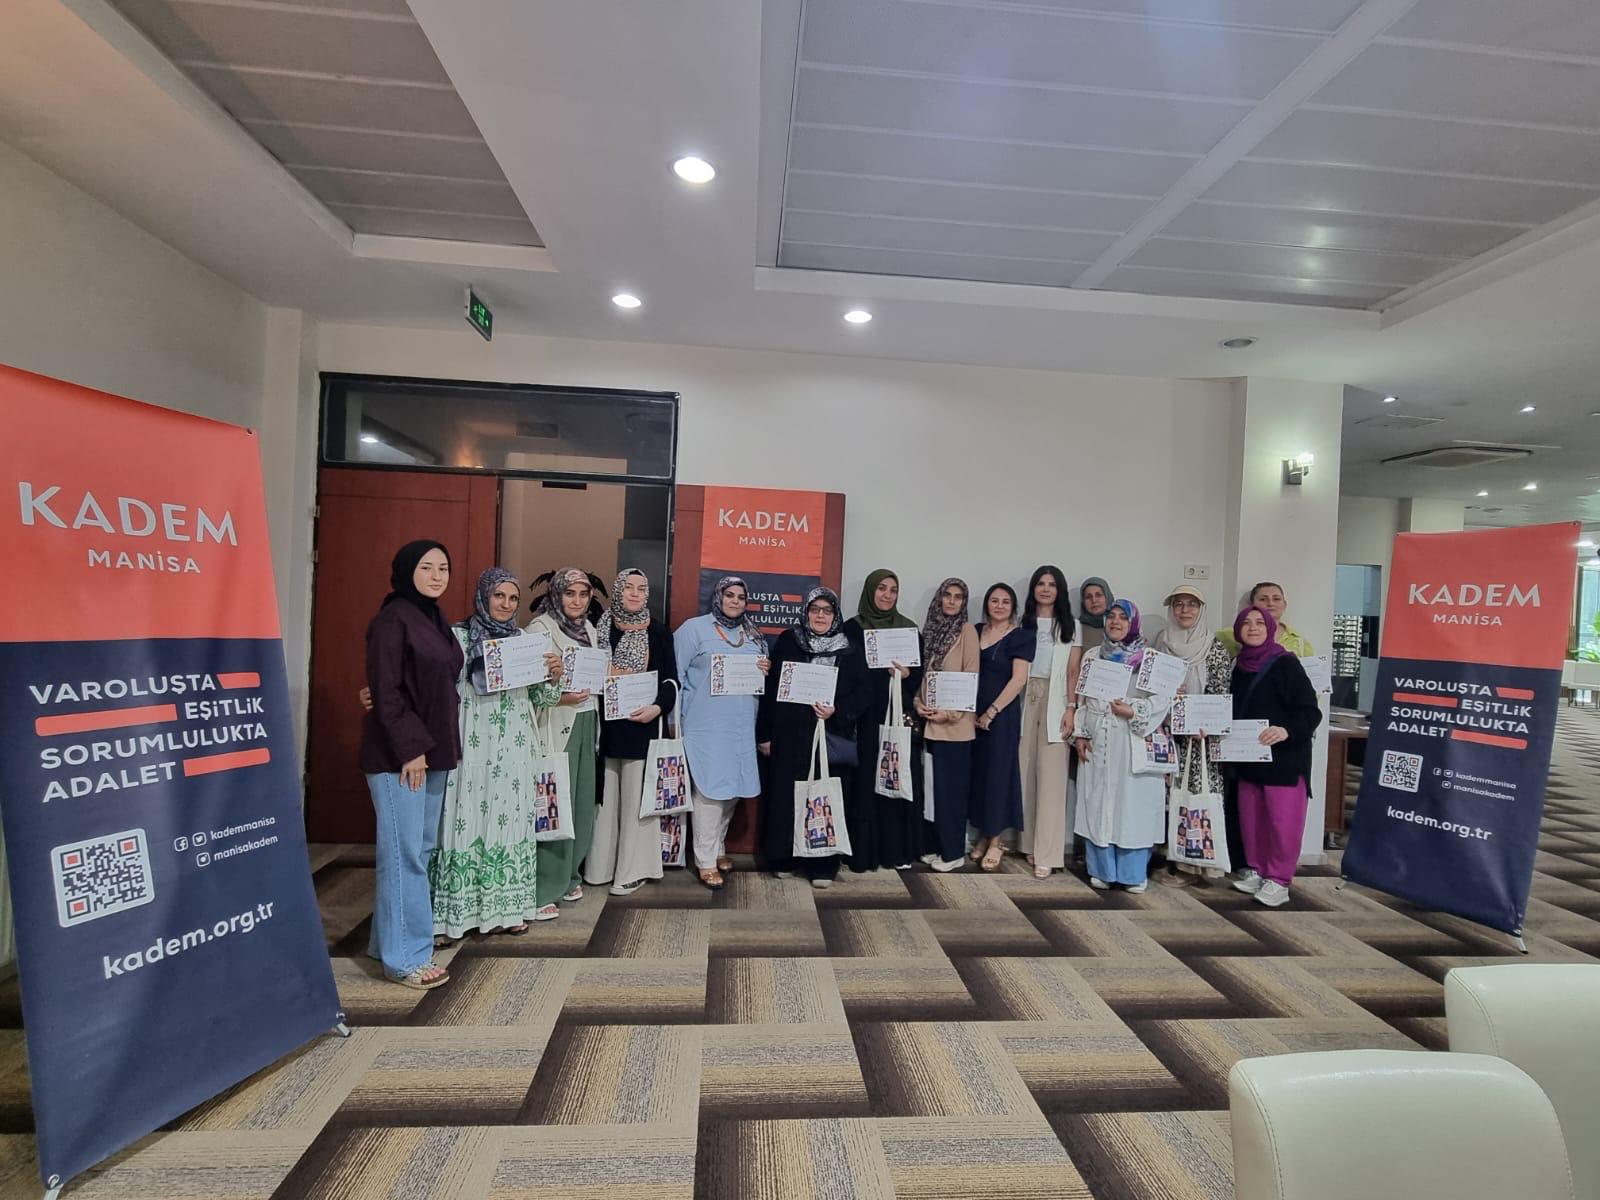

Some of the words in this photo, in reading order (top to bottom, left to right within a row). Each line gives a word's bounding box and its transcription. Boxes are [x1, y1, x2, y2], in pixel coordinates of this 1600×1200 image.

[18, 481, 238, 546] KADEM
[718, 507, 809, 533] KADEM
[739, 535, 786, 548] MANİSA
[88, 548, 201, 574] MANİSA
[747, 592, 780, 602] LUŞTA
[1408, 583, 1541, 608] KADEM
[750, 615, 801, 625] LULUKTA
[1433, 612, 1503, 626] MANİSA
[28, 673, 217, 705] VAROLUŞTA
[1394, 677, 1492, 696] VAROLUŞTA
[1387, 721, 1448, 738] ADALET
[1390, 706, 1529, 733] SORUMLULUKTA
[40, 722, 268, 770] SORUMLULUKTA
[42, 761, 176, 803] ADALET
[210, 815, 276, 841] kademmanisa
[1387, 805, 1493, 840] kadem.org.tr
[213, 834, 278, 861] manisakadem
[102, 902, 275, 980] kadem.org.tr
